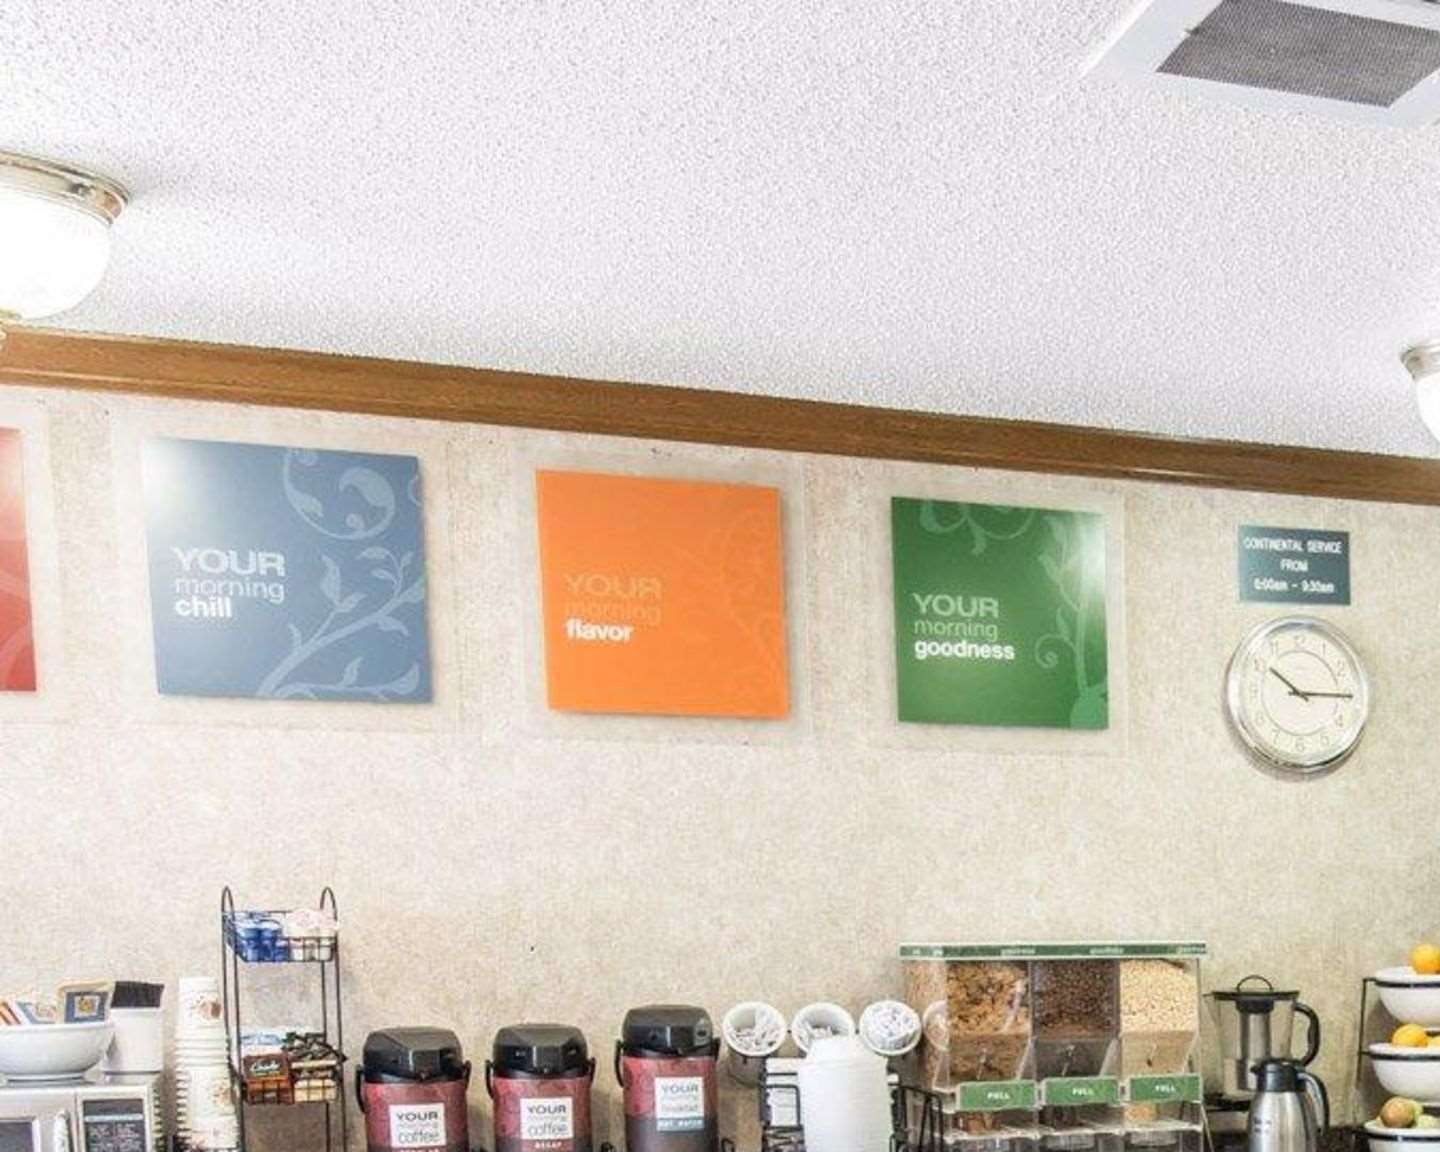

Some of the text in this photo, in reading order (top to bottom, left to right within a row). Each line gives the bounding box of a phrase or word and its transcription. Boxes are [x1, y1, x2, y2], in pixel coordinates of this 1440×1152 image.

[1306, 540, 1343, 554] SERVICE
[171, 547, 286, 577] YOUR
[175, 577, 285, 605] morning
[563, 573, 662, 600] YOUR
[175, 595, 232, 618] chill
[912, 592, 999, 618] YOUR
[565, 617, 634, 643] flavor
[914, 619, 998, 642] morning
[914, 639, 1015, 660] goodness
[661, 1083, 698, 1094] YOUR
[396, 1111, 438, 1121] YOUR
[527, 1104, 567, 1114] YOUR
[398, 1129, 441, 1144] coffee
[528, 1121, 569, 1136] coffee
